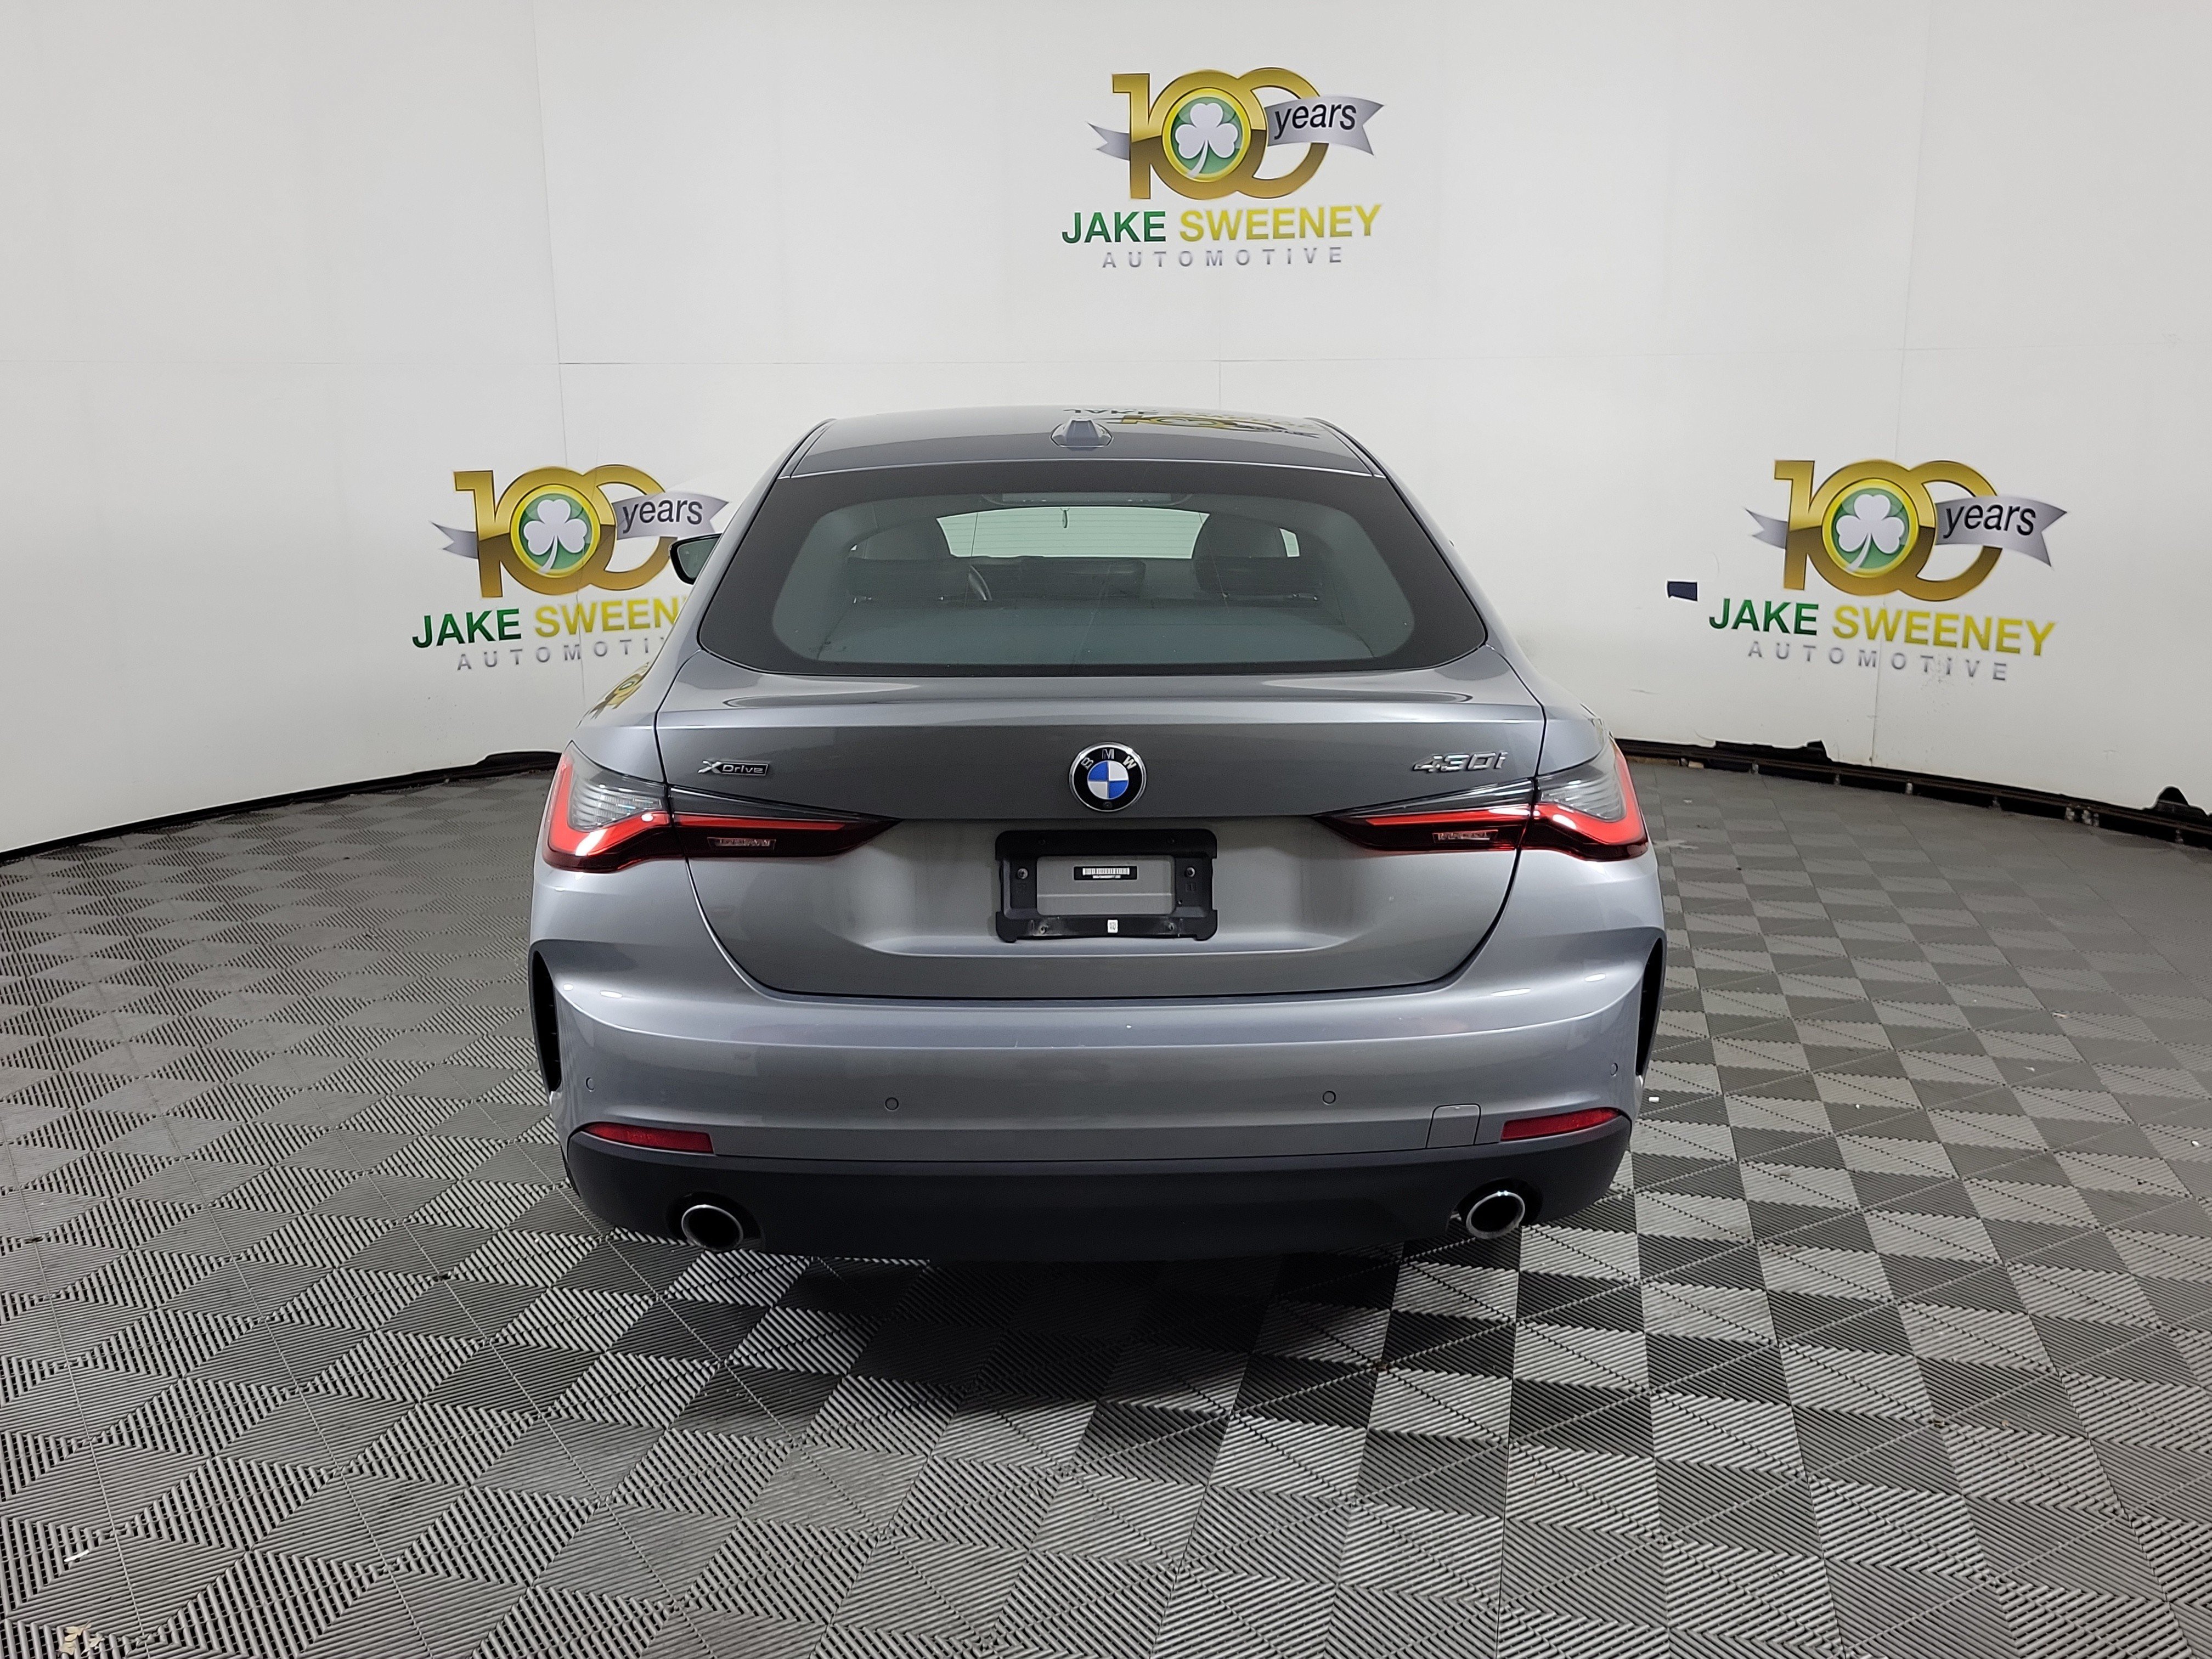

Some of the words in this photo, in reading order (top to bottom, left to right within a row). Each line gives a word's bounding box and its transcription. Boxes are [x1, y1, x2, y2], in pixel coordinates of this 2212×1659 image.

[1273, 102, 1357, 140] years
[1062, 210, 1166, 244] JAKE
[1179, 204, 1382, 242] SWEENEY
[1102, 246, 1342, 268] AUTOMOTIVE
[622, 499, 703, 534] years
[1942, 503, 2037, 539] years
[411, 608, 522, 648] JAKE
[534, 595, 687, 638] SWEEN
[1708, 597, 1819, 636] JAKE
[1832, 605, 2056, 657] SWEENEY
[457, 636, 664, 670] AUTOMOTI
[1748, 641, 2007, 682] AUTOMOTIVE
[1080, 748, 1137, 770] BMW
[1412, 750, 1508, 772] 430i
